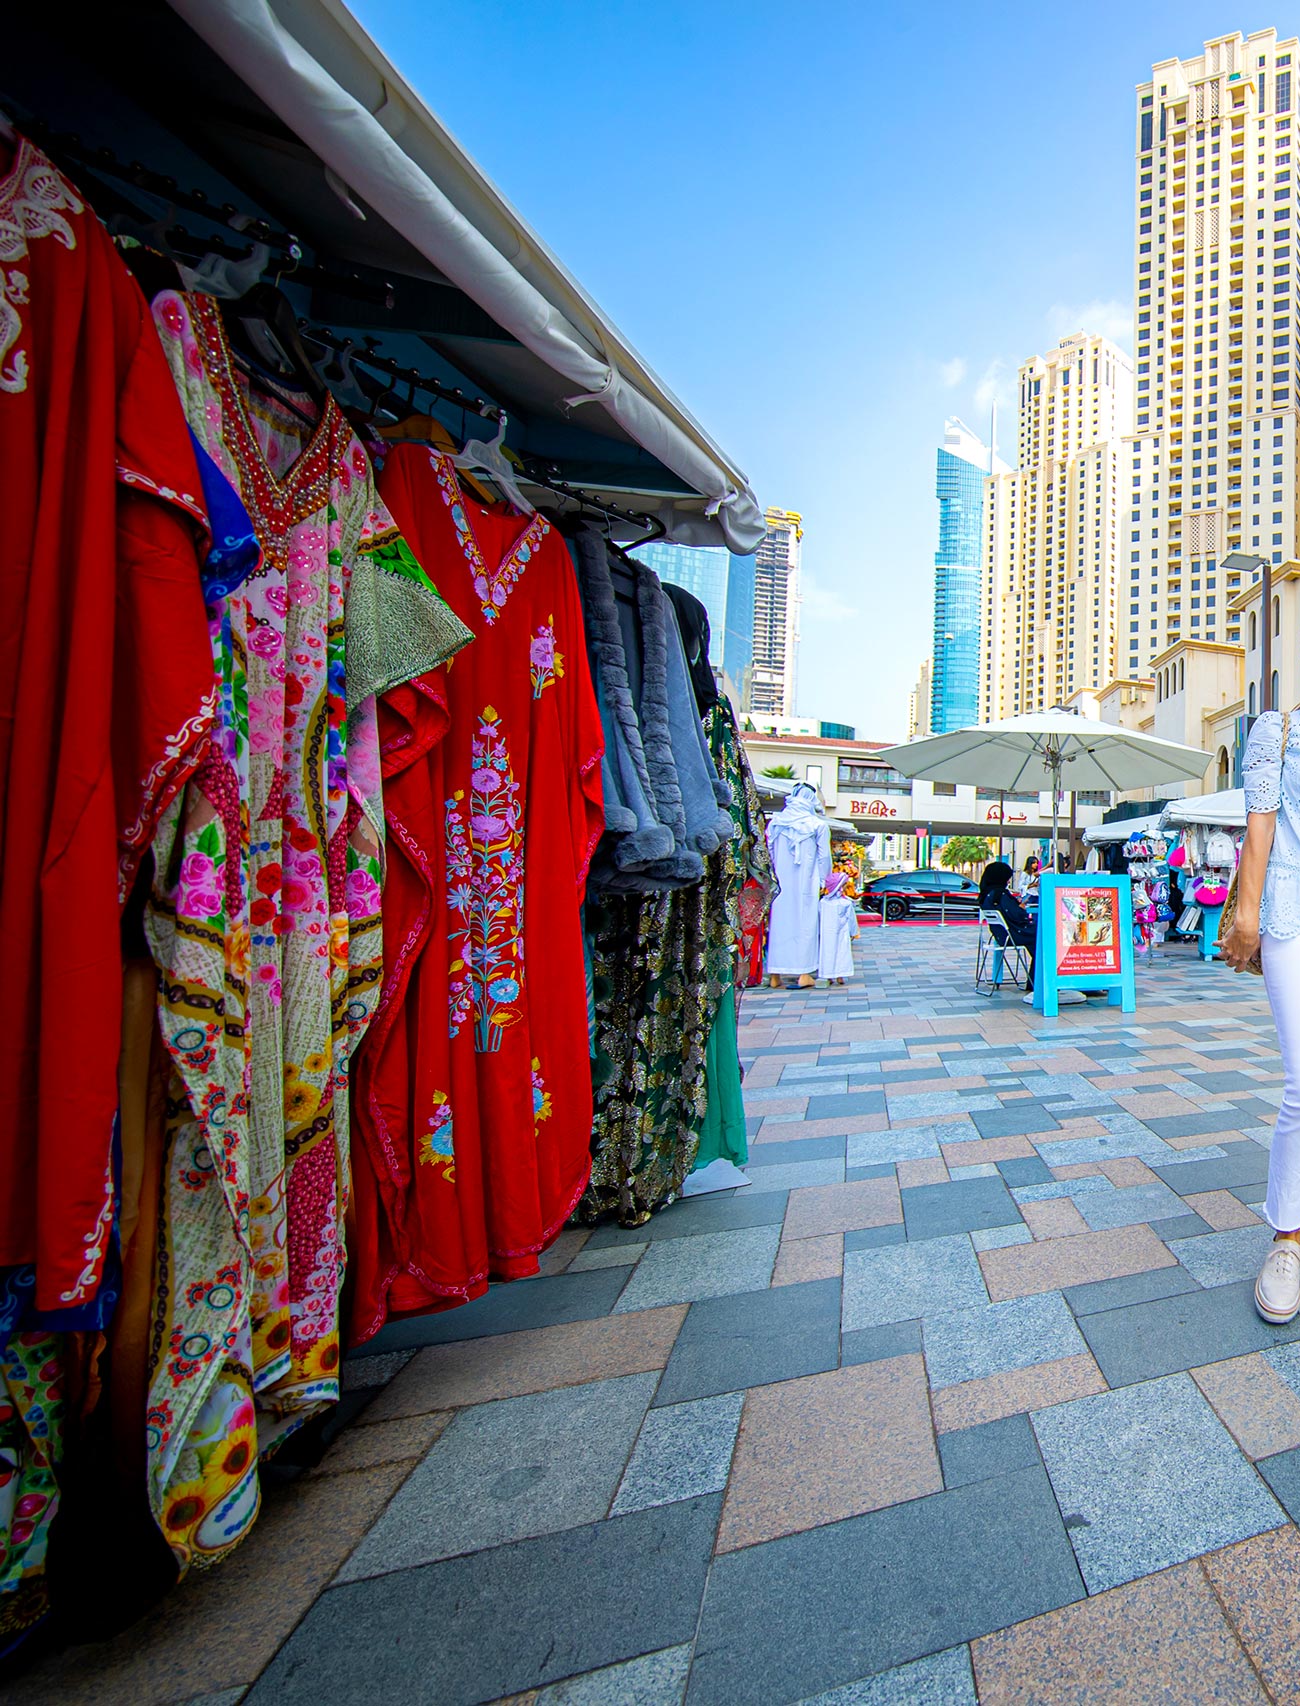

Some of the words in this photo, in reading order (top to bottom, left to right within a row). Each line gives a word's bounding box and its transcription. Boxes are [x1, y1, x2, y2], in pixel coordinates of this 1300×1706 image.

[850, 799, 897, 818] Bridge
[1062, 888, 1086, 896] Henna
[1087, 888, 1112, 898] Design
